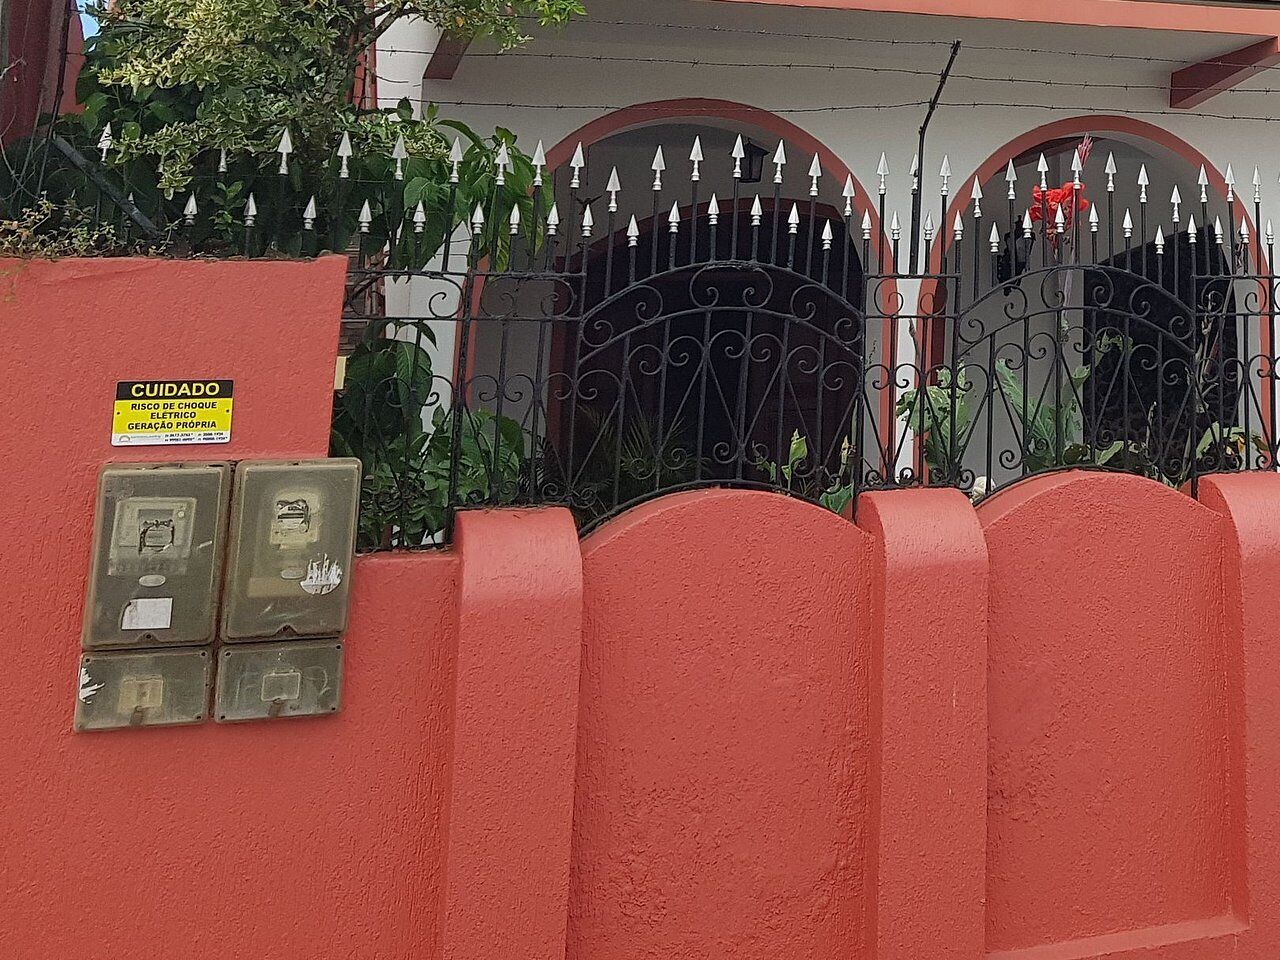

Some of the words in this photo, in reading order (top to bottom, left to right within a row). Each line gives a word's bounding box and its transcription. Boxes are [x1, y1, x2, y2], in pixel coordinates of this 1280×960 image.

[131, 382, 220, 397] CUIDADO
[130, 403, 160, 411] RISCO
[162, 402, 175, 410] DE
[177, 401, 217, 410] CHOQUE
[127, 421, 173, 431] GERAÇÃO
[175, 420, 217, 429] PRÓPRIA
